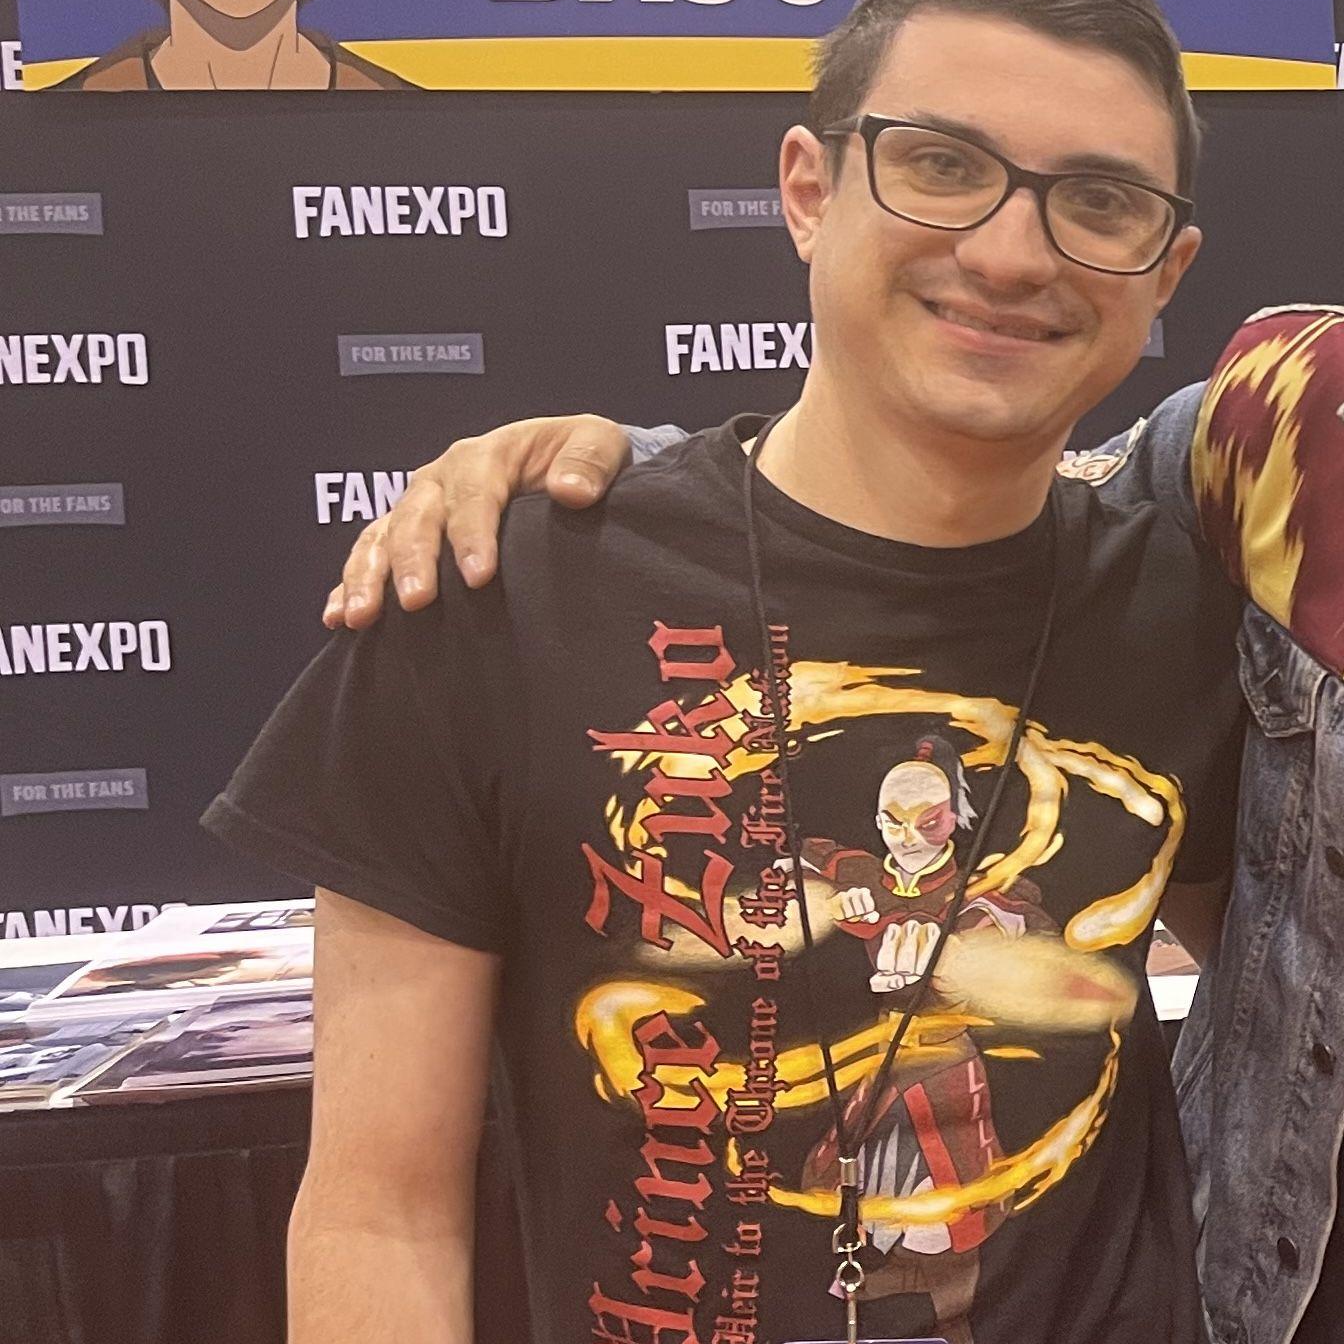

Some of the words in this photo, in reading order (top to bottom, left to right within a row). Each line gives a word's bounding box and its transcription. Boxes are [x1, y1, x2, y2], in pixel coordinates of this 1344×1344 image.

[8, 206, 40, 222] THE
[44, 206, 89, 222] FANS
[293, 185, 508, 238] FANEXPO
[701, 200, 733, 216] FOR
[738, 200, 768, 216] THE
[0, 333, 149, 385] NEXPO
[351, 346, 388, 363] FOR
[392, 346, 424, 362] THE
[427, 344, 471, 362] FANS
[665, 322, 818, 374] FANEX
[0, 498, 24, 514] OR
[28, 497, 61, 513] THE
[66, 495, 111, 512] FANS
[0, 620, 171, 676] NEXPO
[12, 783, 45, 801] FOR
[48, 782, 83, 800] THE
[87, 780, 135, 799] FANS
[581, 620, 738, 958] Zuko
[741, 766, 790, 857] Fire
[741, 866, 798, 929] the
[733, 936, 785, 981] of
[724, 996, 790, 1134] Throne
[725, 1148, 783, 1206] the
[723, 1220, 763, 1256] to
